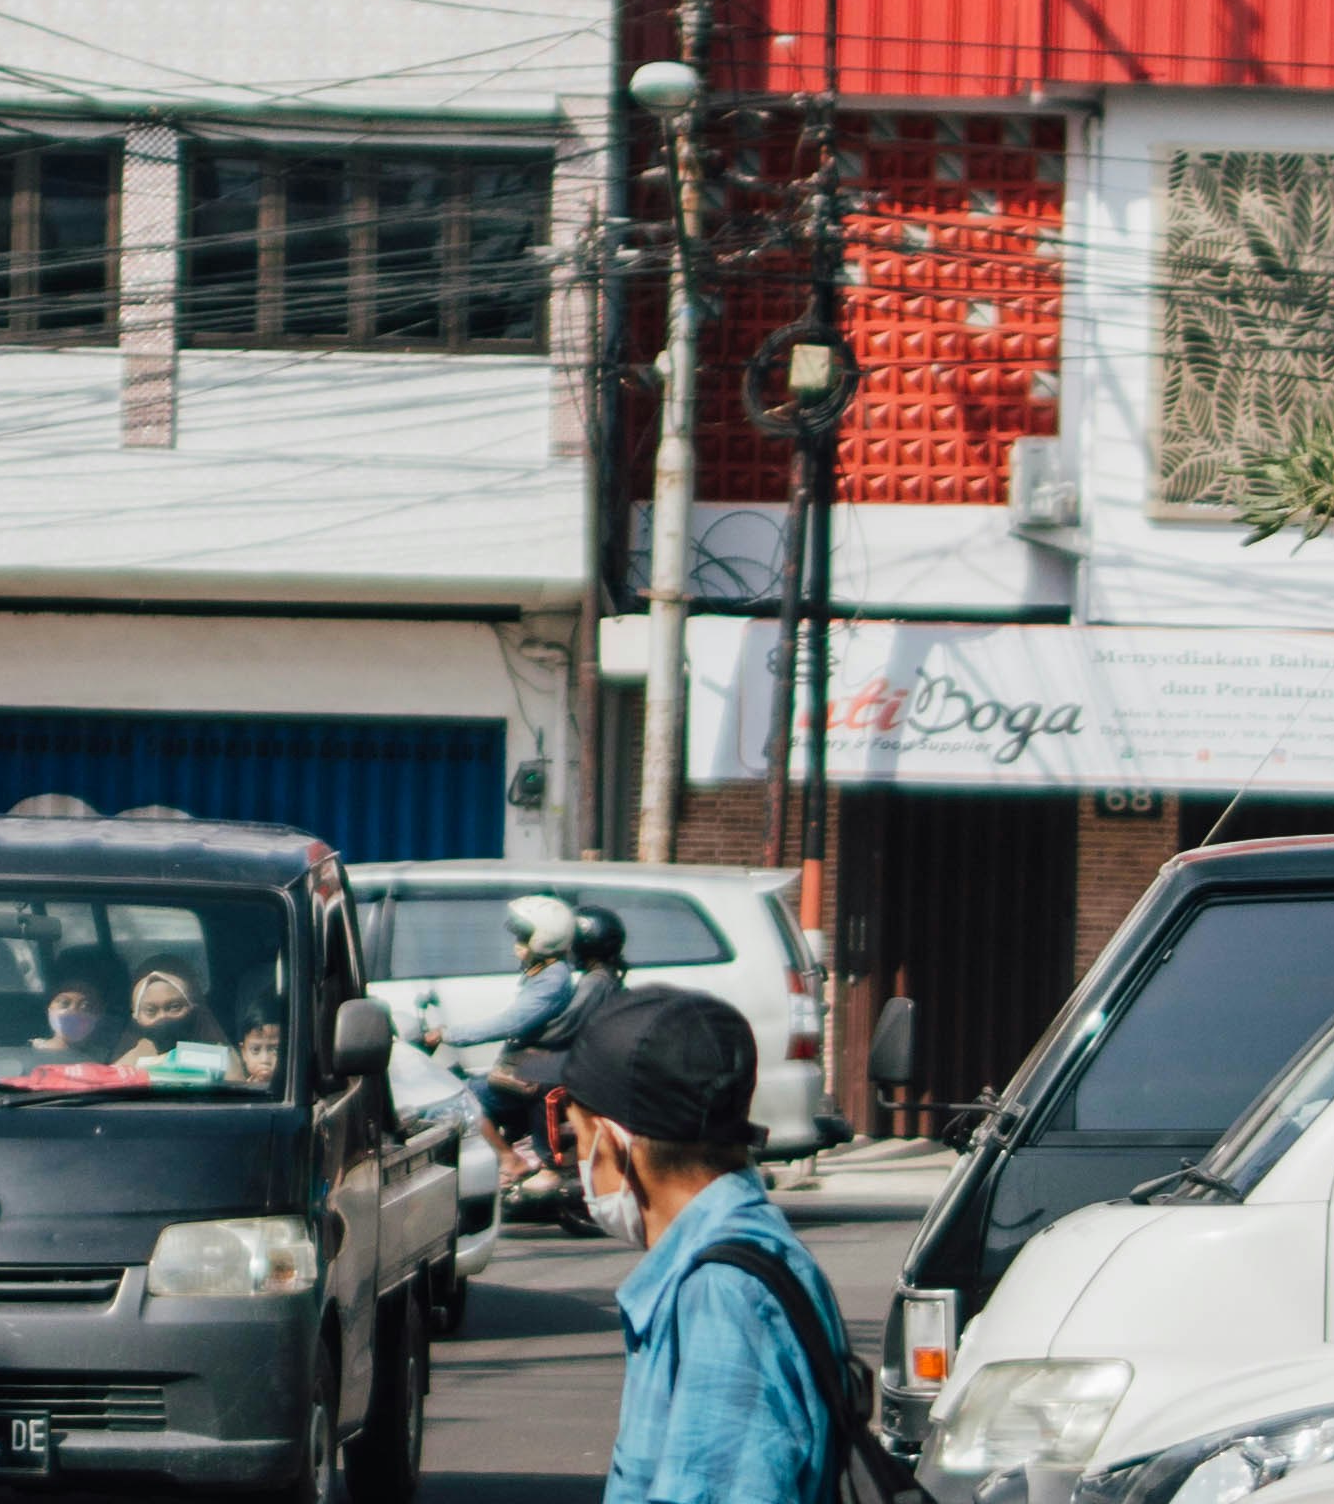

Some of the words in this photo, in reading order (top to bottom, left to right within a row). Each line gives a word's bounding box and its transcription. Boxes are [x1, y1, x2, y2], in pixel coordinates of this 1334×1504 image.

[1161, 680, 1207, 696] dan
[1215, 681, 1334, 699] Peralatan
[908, 666, 1084, 764] Boga
[1105, 785, 1153, 811] 68
[12, 1419, 45, 1452] DE
